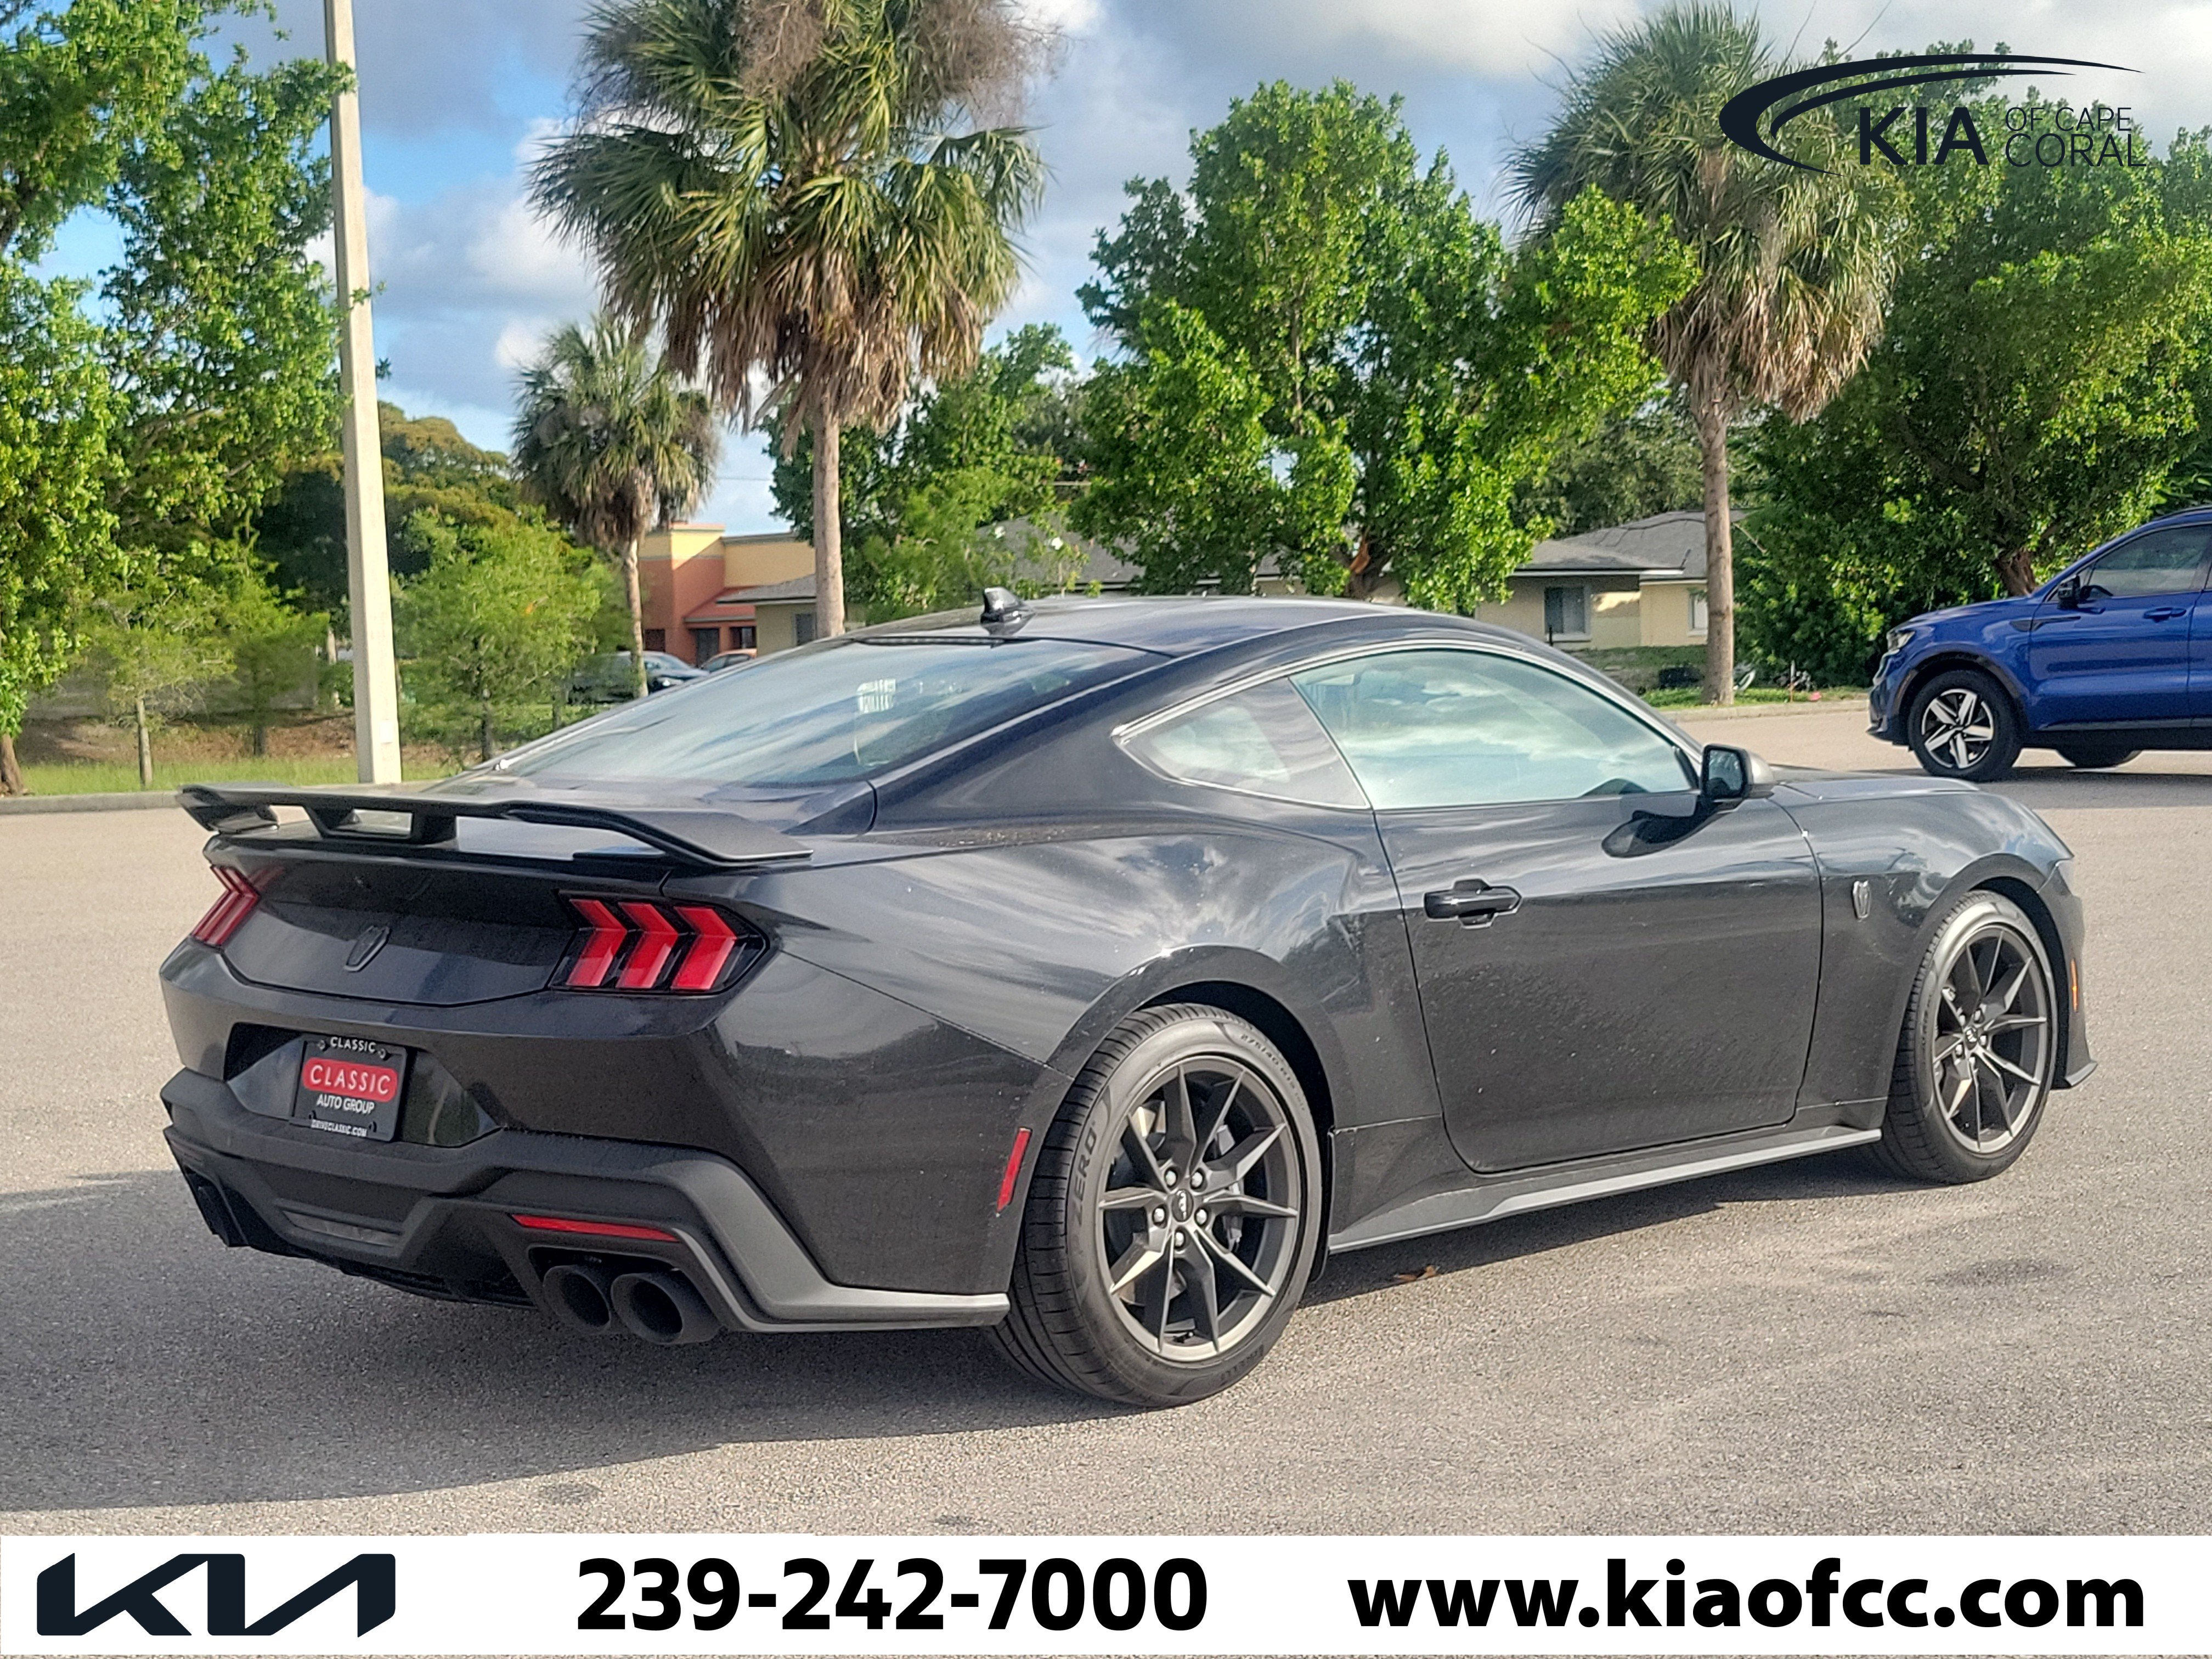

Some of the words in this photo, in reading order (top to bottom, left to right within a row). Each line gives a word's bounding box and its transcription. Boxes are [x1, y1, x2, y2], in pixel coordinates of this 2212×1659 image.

[330, 1036, 376, 1053] CLASSIC
[309, 1064, 391, 1095] CLASSIC
[316, 1093, 342, 1109] AUTO
[343, 1097, 375, 1114] GROUP
[1073, 1126, 1097, 1228] ZERO
